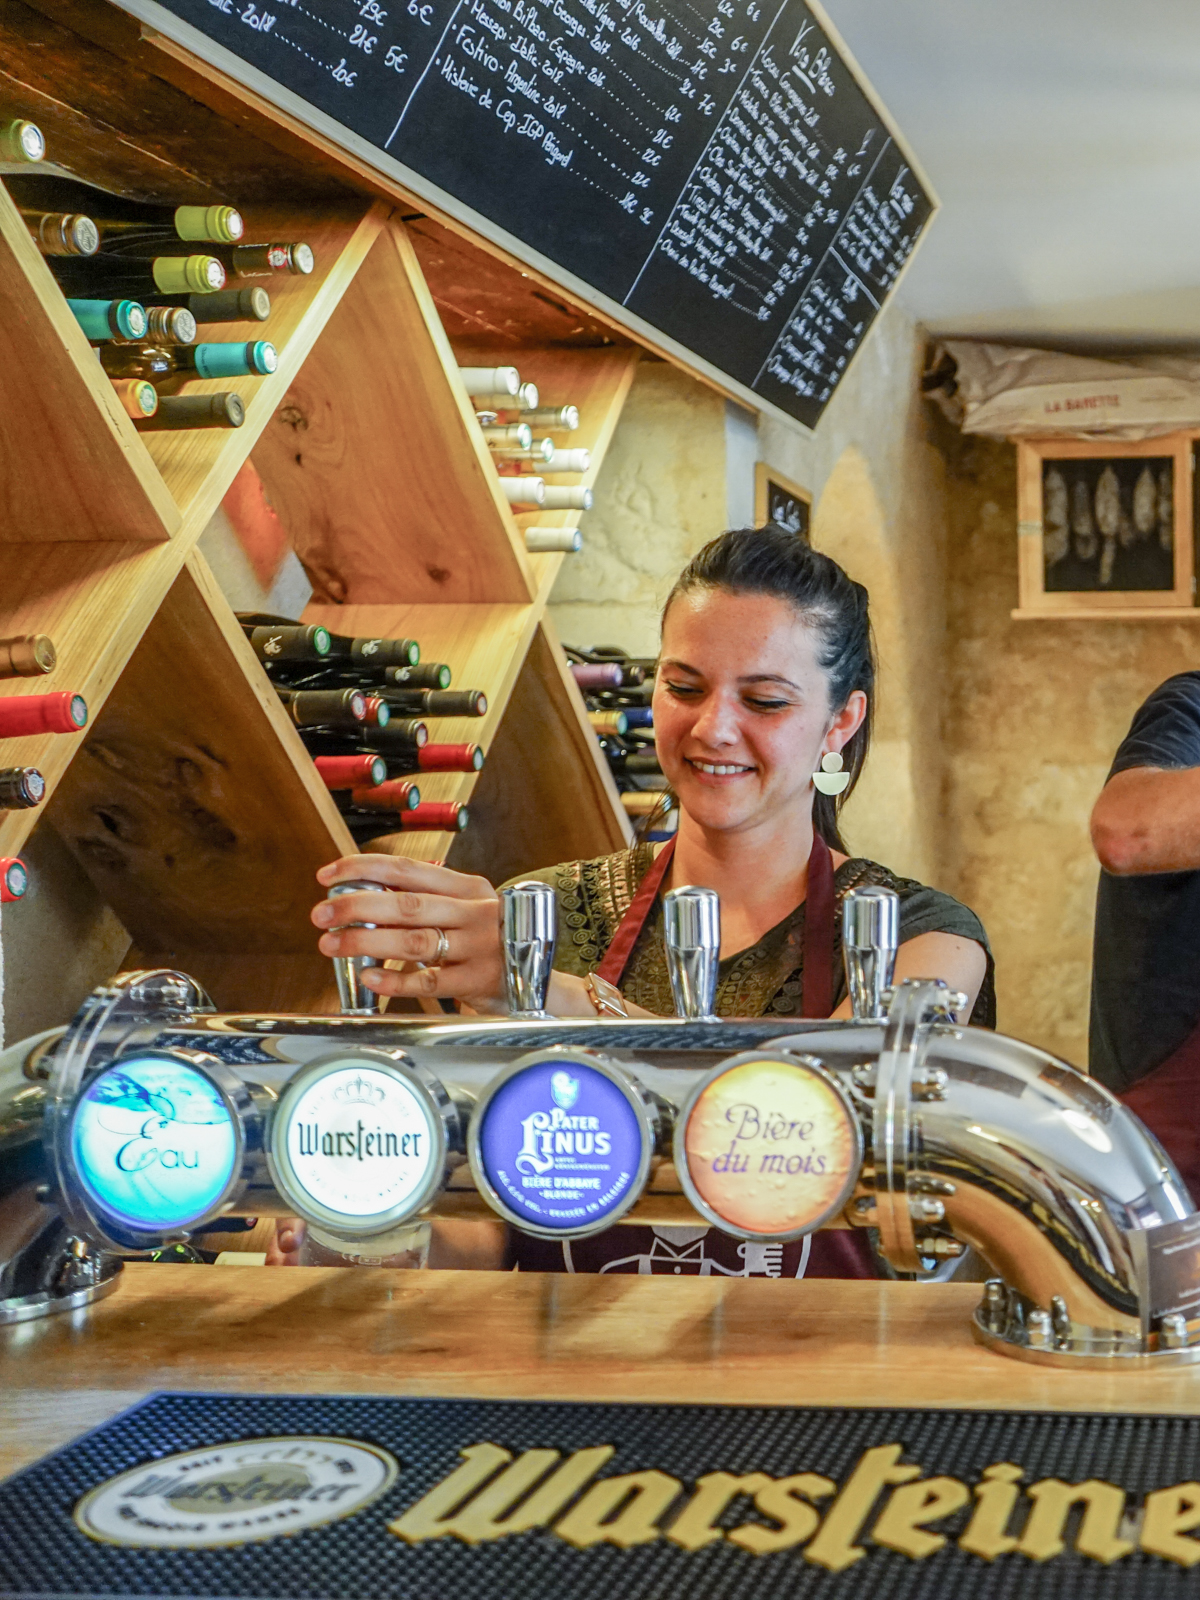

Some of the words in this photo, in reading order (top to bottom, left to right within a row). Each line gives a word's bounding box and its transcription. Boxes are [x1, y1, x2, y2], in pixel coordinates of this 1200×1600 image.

[553, 0, 586, 37] Georges
[746, 1, 761, 22] 6€
[241, 3, 277, 32] 2018
[332, 58, 358, 87] 20€
[513, 0, 546, 42] Bilbao
[548, 37, 585, 74] Espagne
[730, 35, 748, 52] 6€
[789, 19, 813, 69] Vins
[808, 47, 835, 96] Blancs
[384, 45, 408, 73] 5€
[509, 35, 538, 67] Italie
[541, 59, 564, 84] 2018
[594, 2, 616, 33] Vignes
[620, 27, 641, 51] 2016
[697, 93, 716, 116] 7€
[717, 57, 737, 73] 3€
[441, 54, 479, 98] Histoire
[478, 88, 493, 109] de
[495, 99, 516, 133] Cep
[517, 113, 545, 140] IGP
[541, 131, 573, 167] Périgord
[504, 60, 540, 104] Argentine
[543, 95, 567, 119] 2018
[298, 1119, 422, 1161] Warsteiner
[549, 1107, 600, 1131] PATER
[725, 1103, 814, 1142] Bière
[115, 1113, 199, 1172] Eau
[515, 1111, 612, 1175] LINUS
[711, 1140, 749, 1174] du
[758, 1146, 827, 1177] mois
[522, 1173, 553, 1189] BIÈRE
